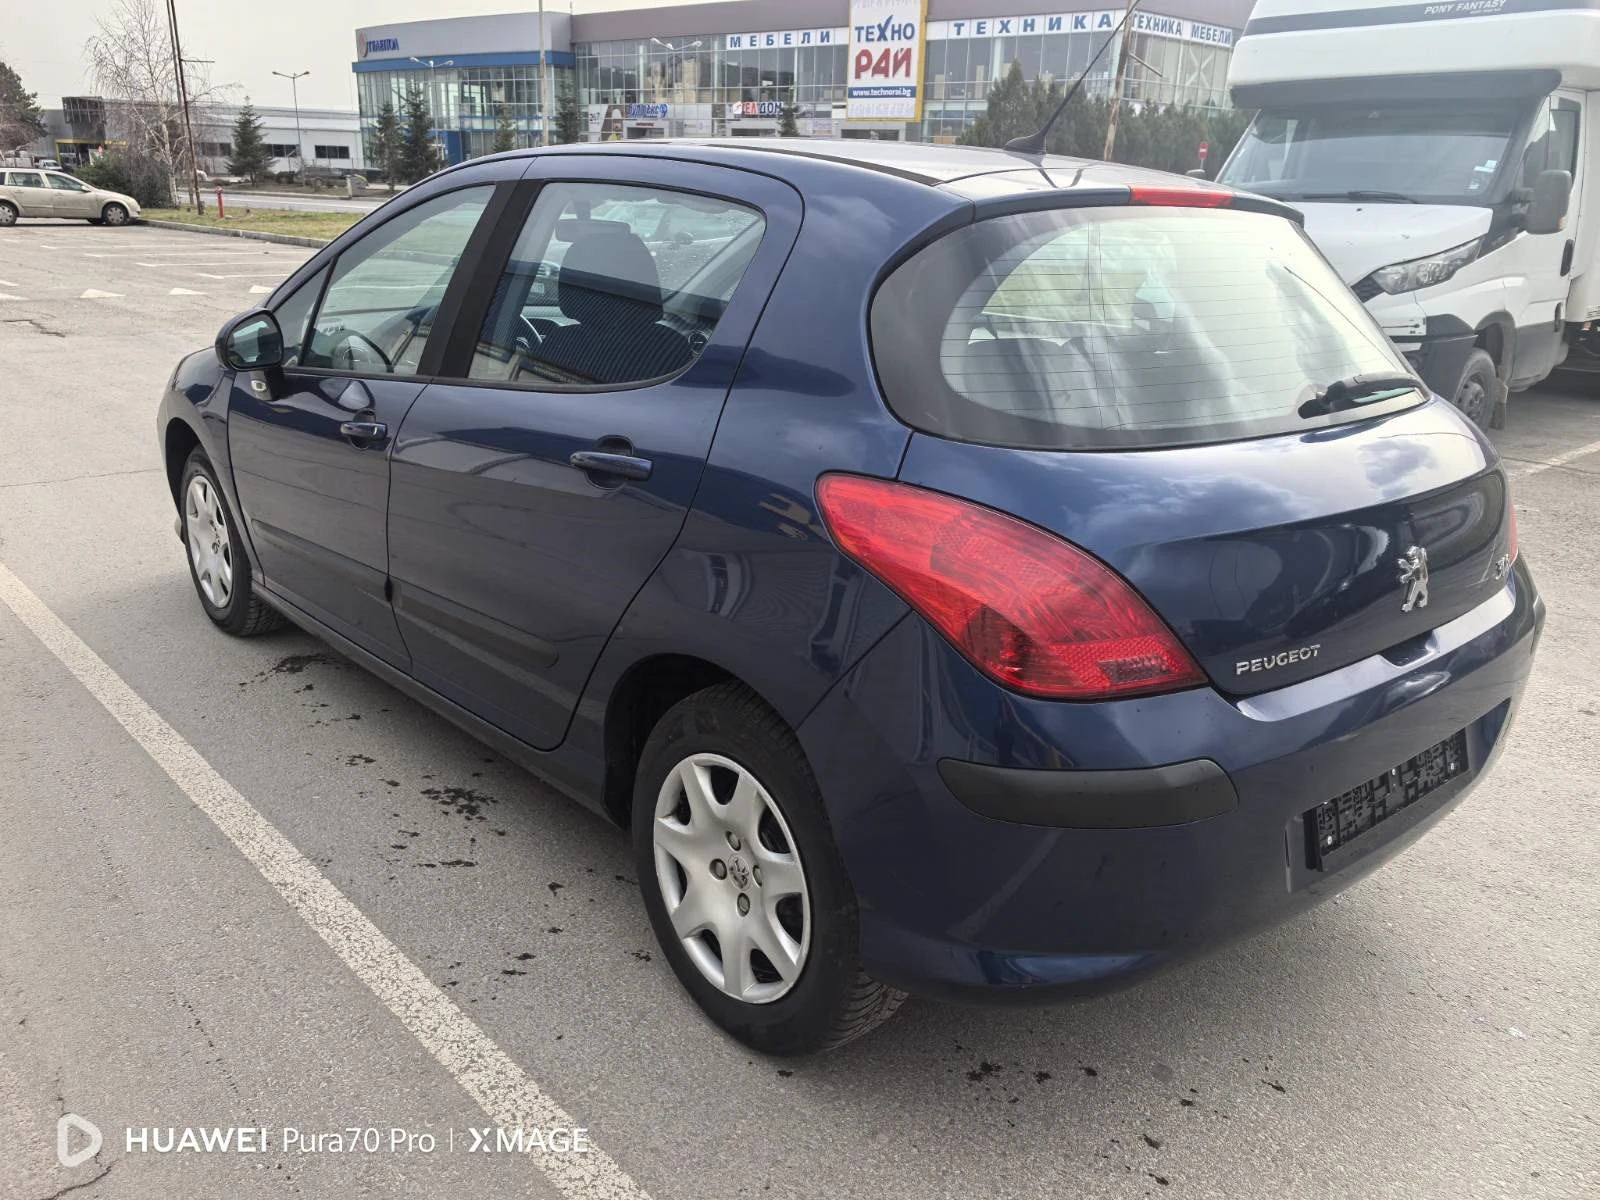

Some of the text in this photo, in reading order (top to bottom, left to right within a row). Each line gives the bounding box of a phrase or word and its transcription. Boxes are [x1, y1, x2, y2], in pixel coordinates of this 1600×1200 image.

[1424, 4, 1455, 15] PONY
[1456, 0, 1506, 12] FANTASY
[854, 14, 916, 43] ТЕХНО
[953, 13, 1112, 36] ТЕХНИКА
[1191, 24, 1232, 44] МЕБЕЛИ
[729, 30, 831, 48] МЕБЕЛИ
[854, 48, 912, 80] РАЙ
[852, 88, 912, 98] www.technorai.bg
[1236, 643, 1321, 676] PEUGEOT
